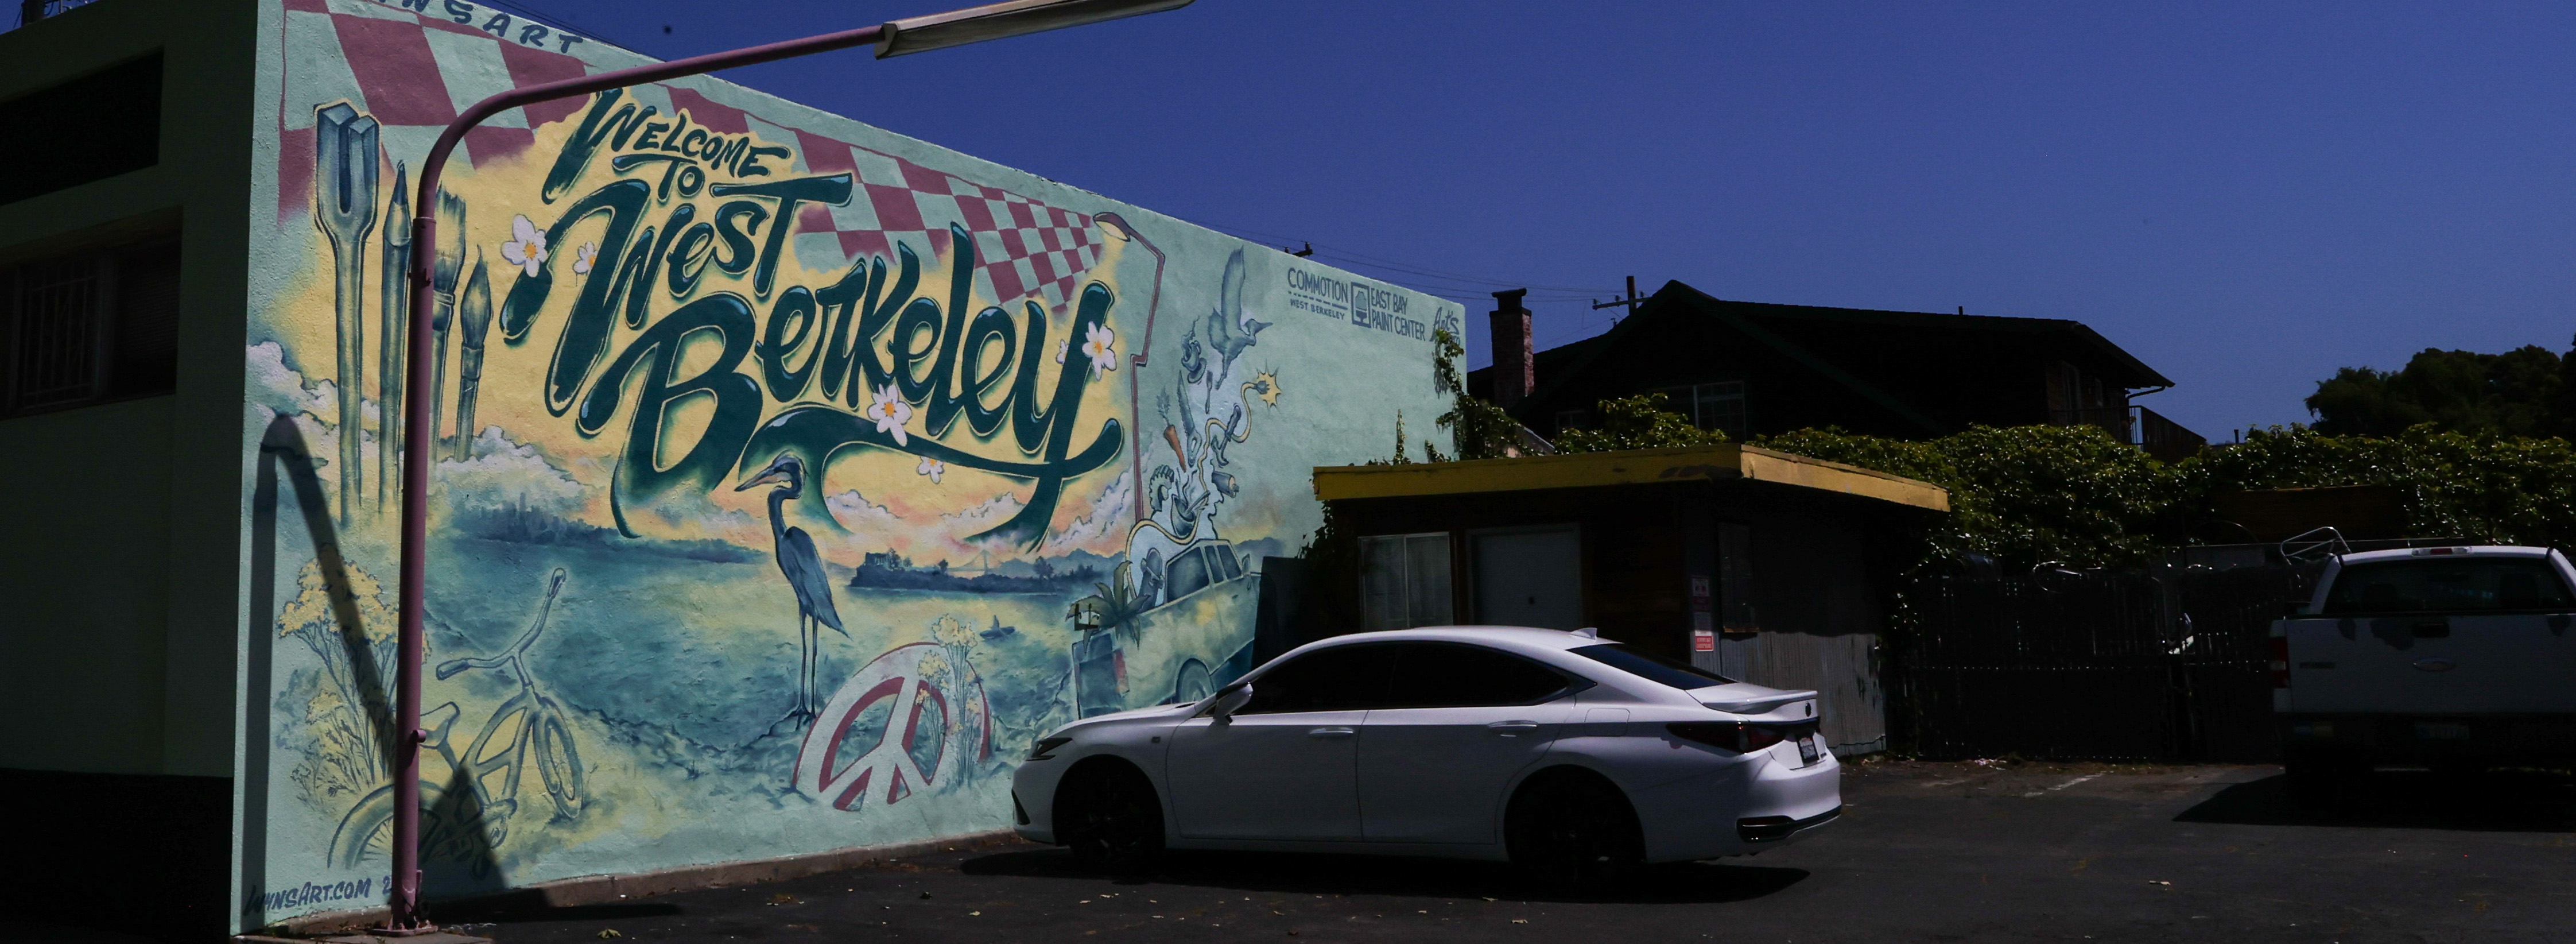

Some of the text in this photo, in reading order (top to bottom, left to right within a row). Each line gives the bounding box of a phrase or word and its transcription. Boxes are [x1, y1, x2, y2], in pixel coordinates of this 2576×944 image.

[542, 86, 791, 204] WELCOME
[1287, 267, 1348, 304] COMMOTION
[1370, 287, 1408, 315] EAST BAY
[1290, 298, 1345, 320] WEST BERKELEY
[1371, 308, 1393, 332] PAINT
[1394, 316, 1426, 342] CENTER
